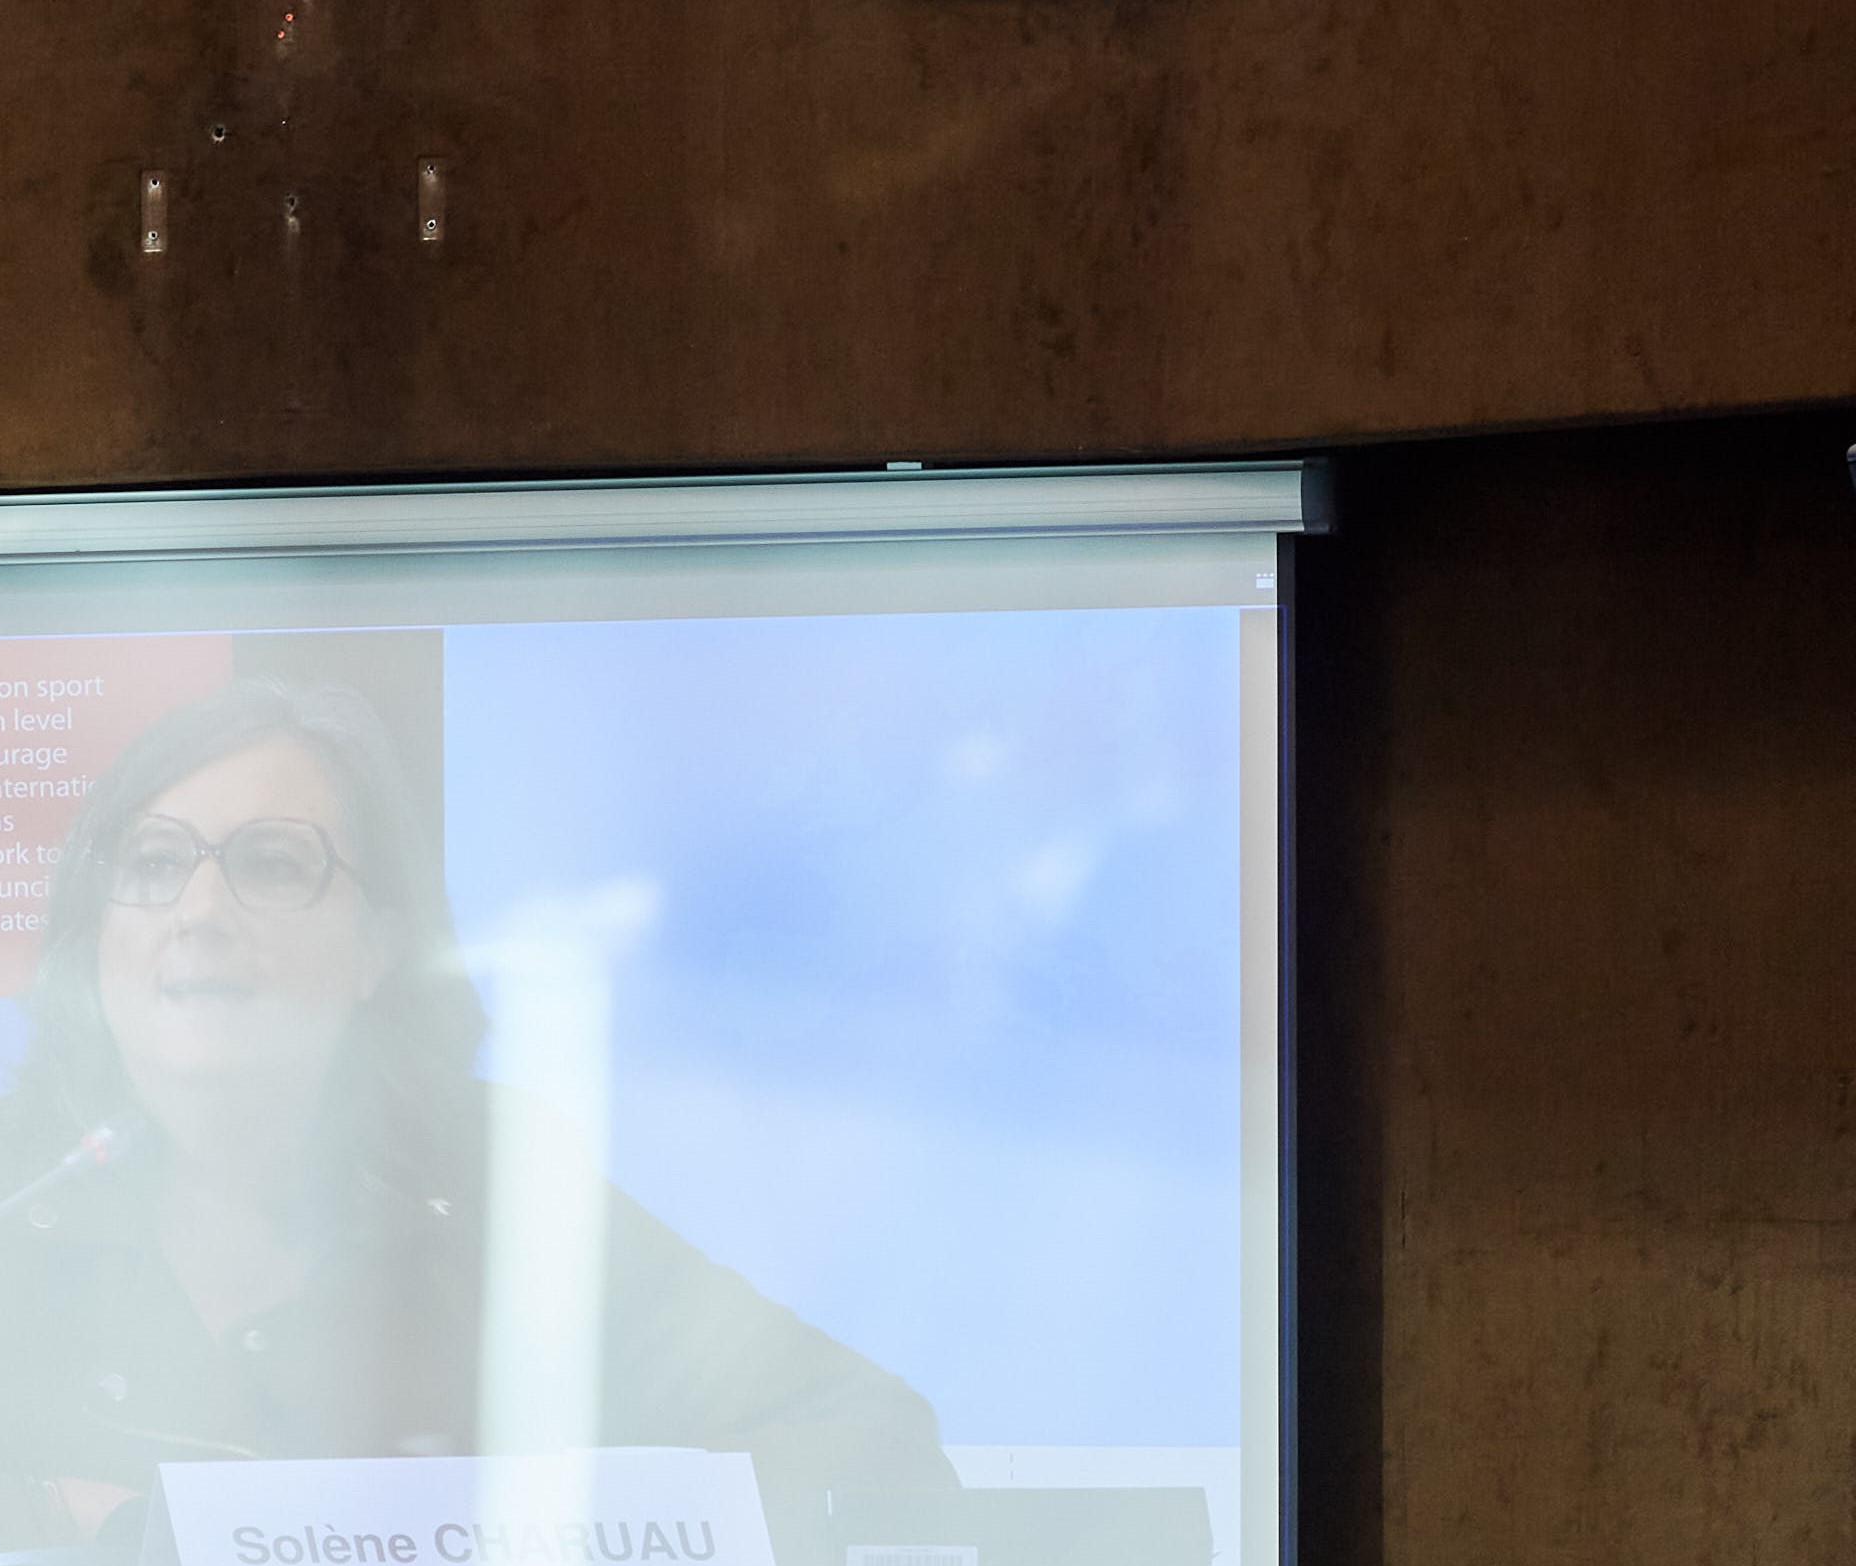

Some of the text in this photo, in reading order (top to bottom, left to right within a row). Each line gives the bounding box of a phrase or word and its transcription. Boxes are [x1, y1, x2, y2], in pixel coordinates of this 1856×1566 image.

[36, 676, 104, 702] sport
[14, 708, 72, 731] level
[231, 1519, 717, 1566] Solène CHARUAU
